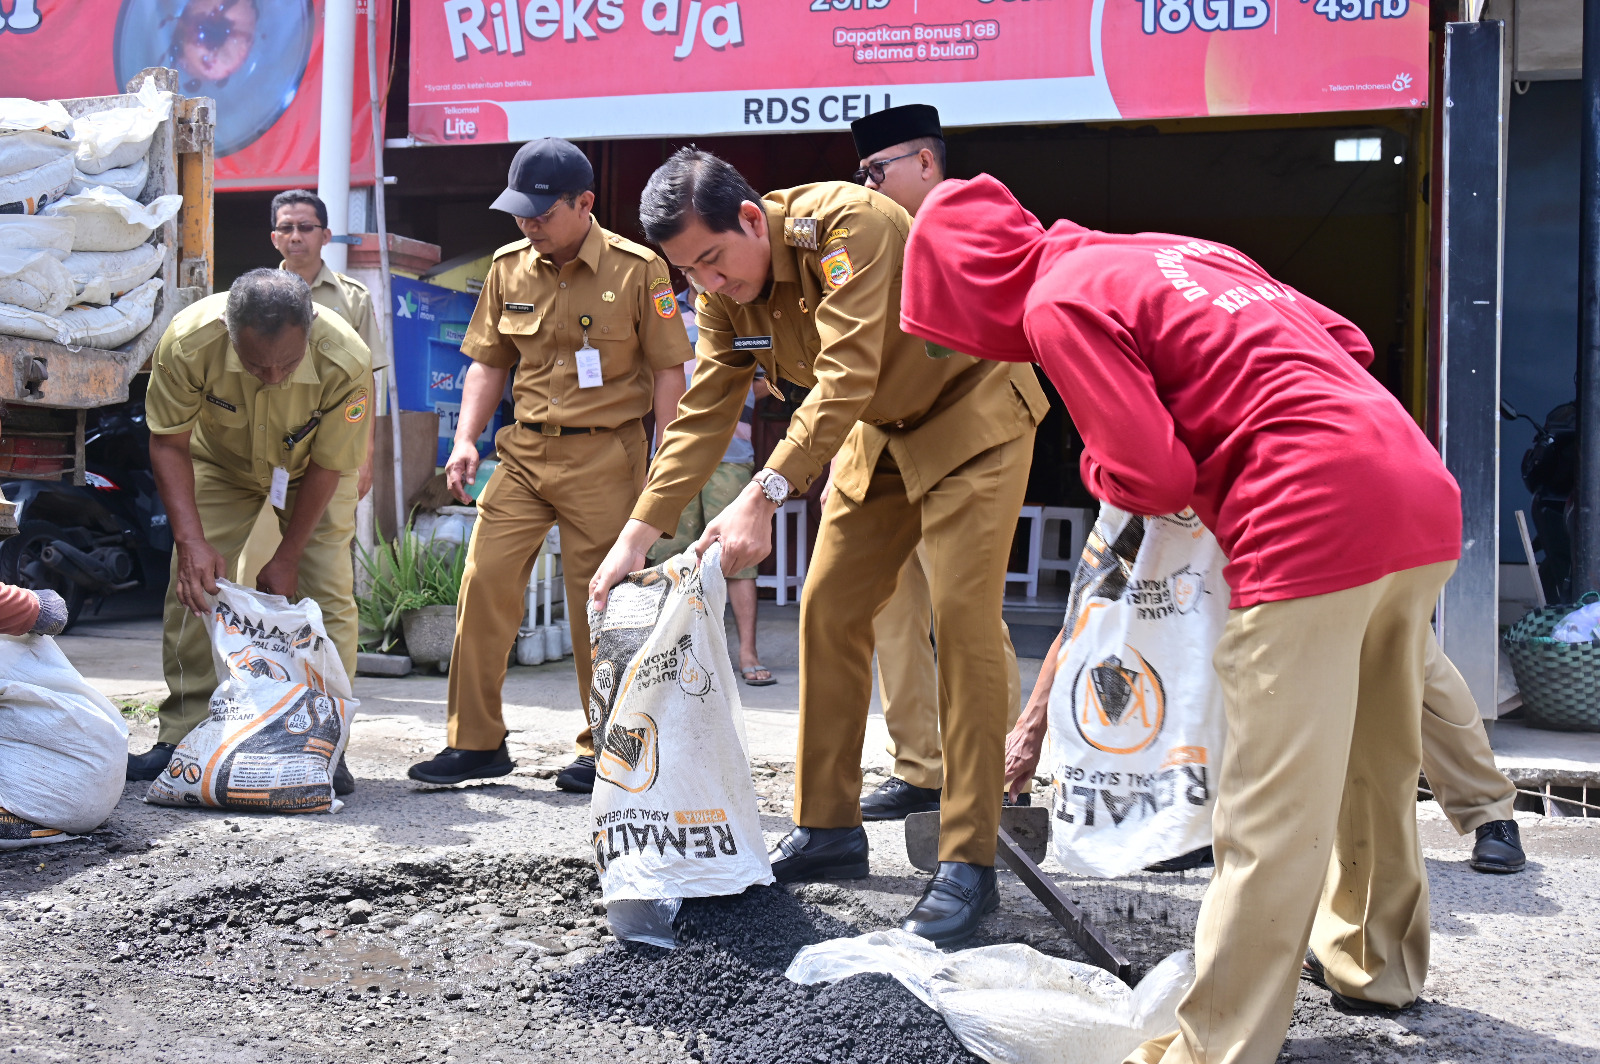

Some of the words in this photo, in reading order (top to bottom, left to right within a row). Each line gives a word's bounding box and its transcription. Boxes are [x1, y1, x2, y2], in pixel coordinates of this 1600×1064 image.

[444, 0, 625, 60] Rileks
[641, 0, 744, 59] aja
[836, 28, 911, 46] Dapatkan
[914, 24, 961, 40] Bonus
[965, 24, 970, 38] 1
[974, 23, 996, 37] GB
[856, 43, 913, 60] selama
[917, 45, 926, 59] 6
[930, 42, 975, 57] bulan
[467, 81, 504, 89] ketentuan
[1329, 84, 1355, 92] Telkom
[1356, 82, 1391, 90] Indonesia
[444, 105, 480, 114] Telkomsel
[744, 98, 810, 124] RDS
[444, 118, 477, 138] Lite
[1212, 286, 1260, 315] KEC
[600, 677, 611, 690] OIL
[293, 713, 307, 722] OIL
[288, 722, 307, 730] BASE
[595, 809, 621, 826] GELAR
[639, 808, 669, 822] ASPAL
